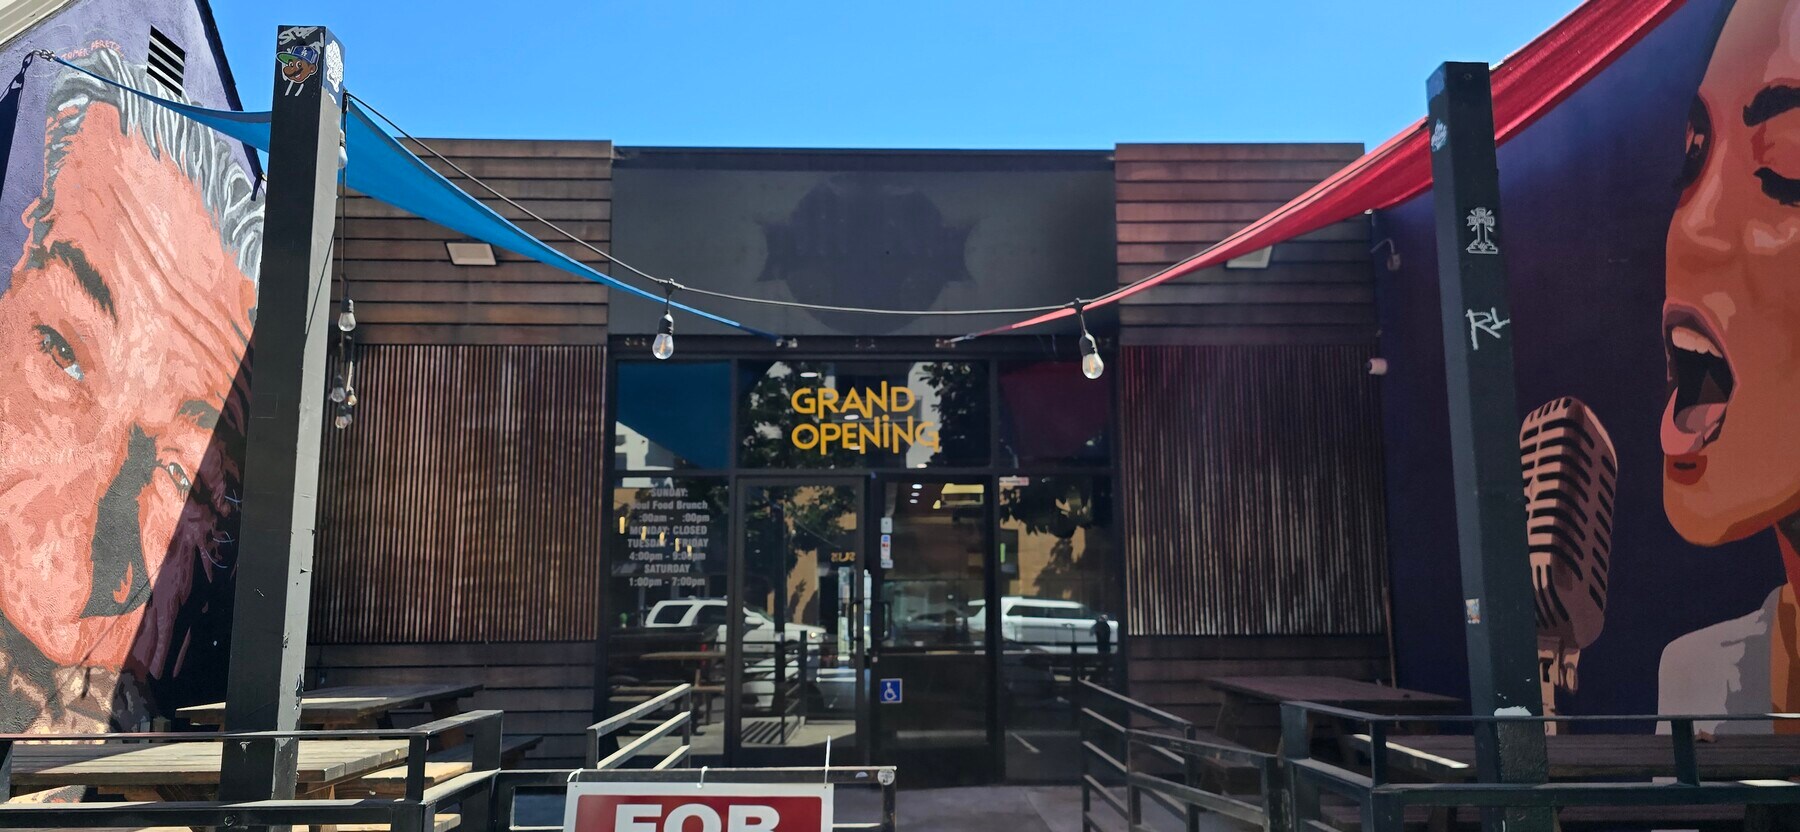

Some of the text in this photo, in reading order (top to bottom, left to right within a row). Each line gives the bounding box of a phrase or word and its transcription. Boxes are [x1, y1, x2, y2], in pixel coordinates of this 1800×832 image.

[790, 380, 916, 419] GRAND
[650, 488, 689, 497] SUNDAY:
[652, 500, 674, 509] Food
[676, 500, 708, 509] Brunch
[673, 526, 708, 535] CLOSED
[629, 551, 663, 562] 4:00pm
[644, 564, 691, 573] SATURDAY
[629, 577, 662, 588] 1:00pm
[672, 577, 706, 588] 7:00pm
